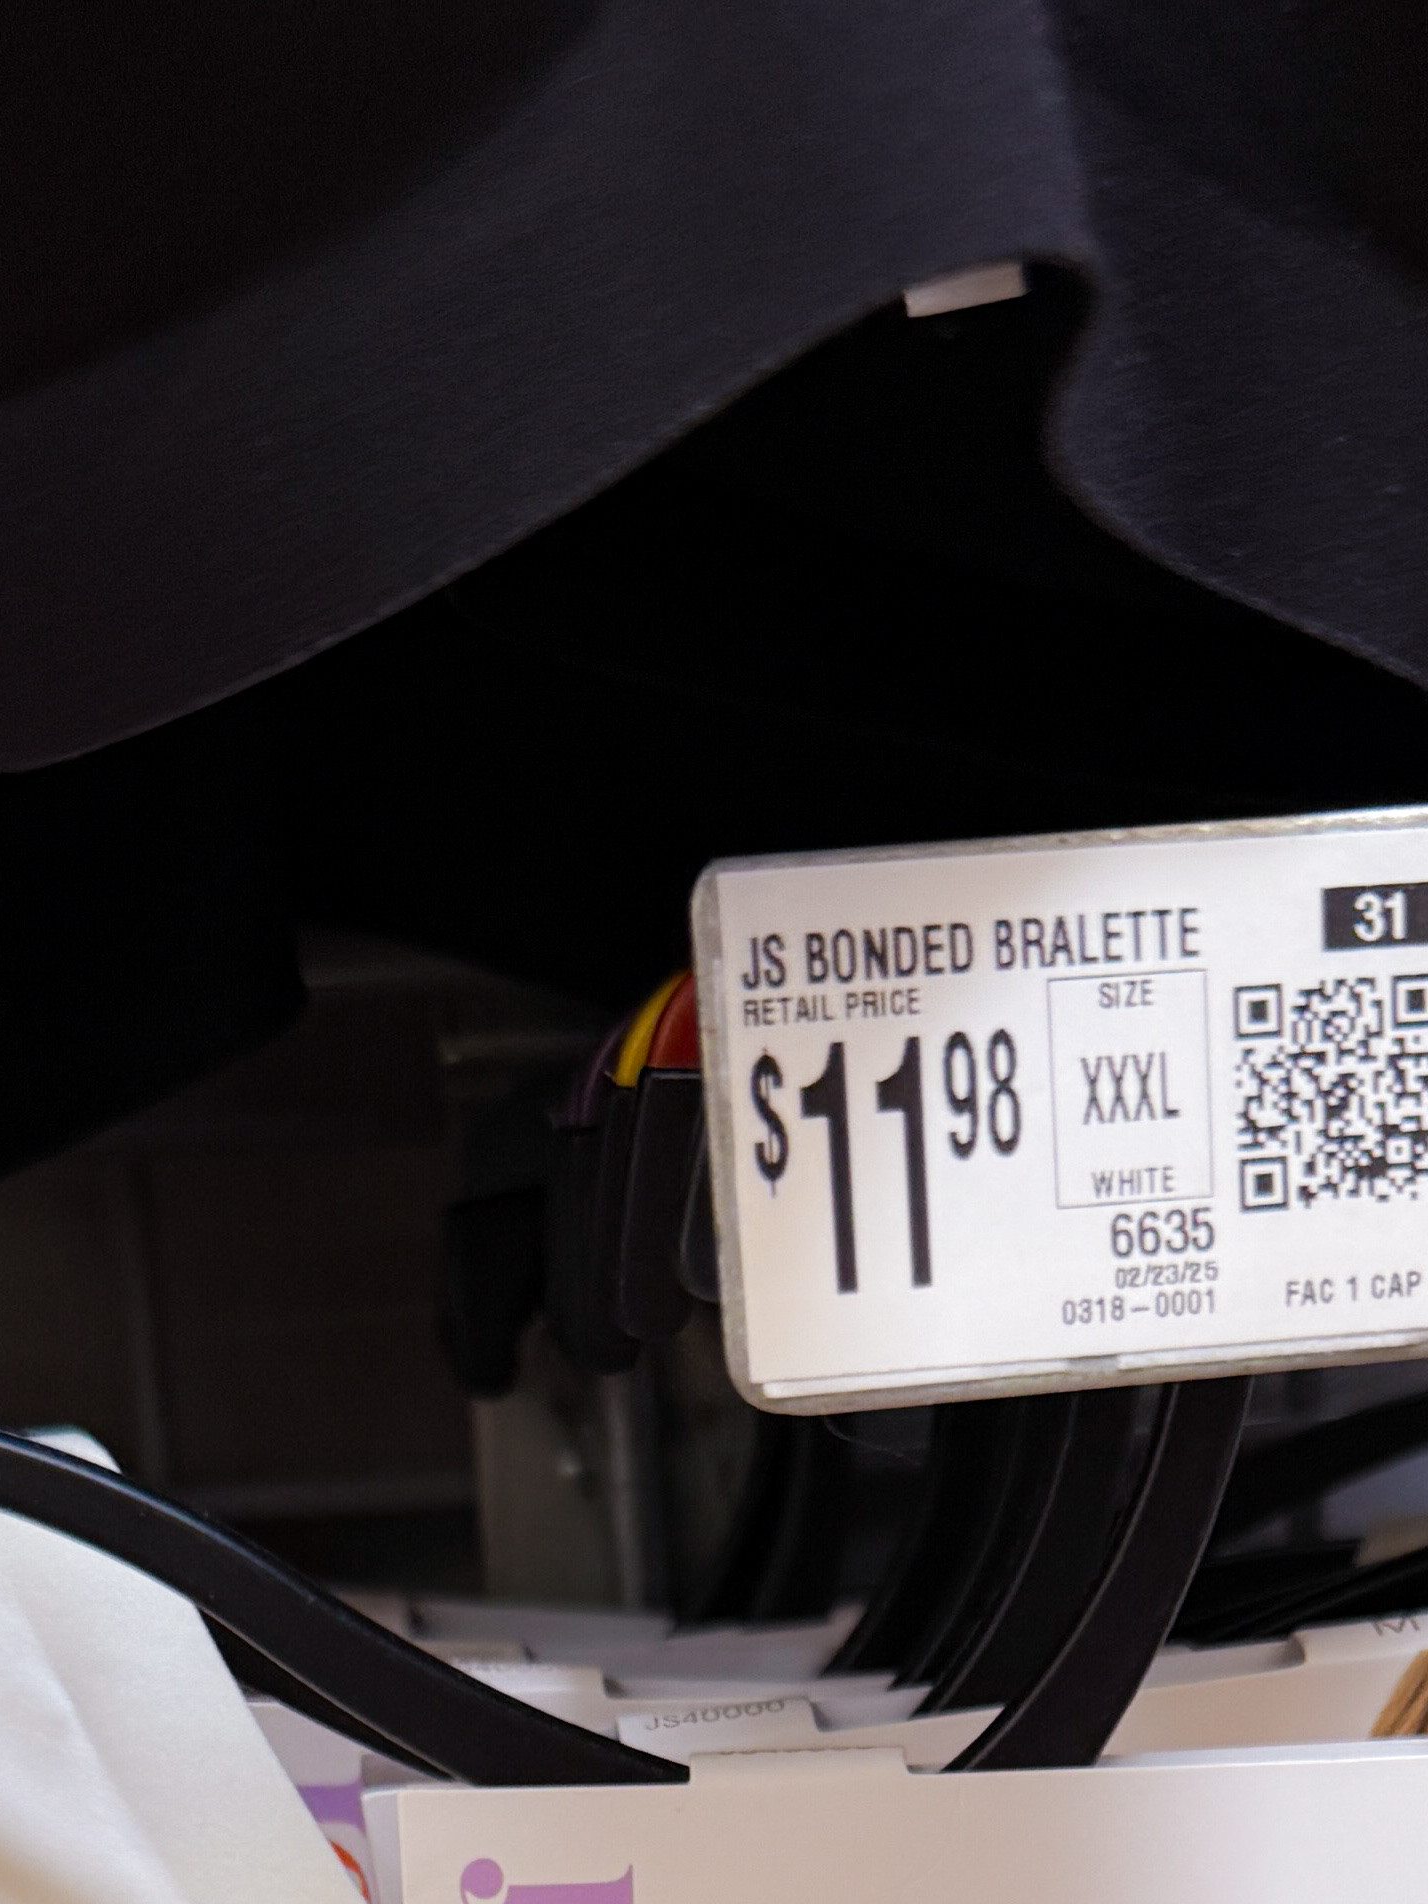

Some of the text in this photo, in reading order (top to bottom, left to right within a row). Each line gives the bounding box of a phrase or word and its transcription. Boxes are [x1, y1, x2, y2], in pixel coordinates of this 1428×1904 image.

[1352, 890, 1407, 942] 31
[741, 907, 1201, 990] JS BONDED BRALETTE
[743, 988, 922, 1027] RETAIL PRICE
[1099, 982, 1156, 1011] SIZE
[1079, 1050, 1180, 1127] XXXL
[1091, 1165, 1176, 1198] WHITE
[1110, 1206, 1215, 1259] 6635
[1115, 1261, 1220, 1291] 02/23/25
[1285, 1276, 1335, 1308] FAC
[1346, 1276, 1358, 1303] 1
[1371, 1270, 1422, 1300] CAP
